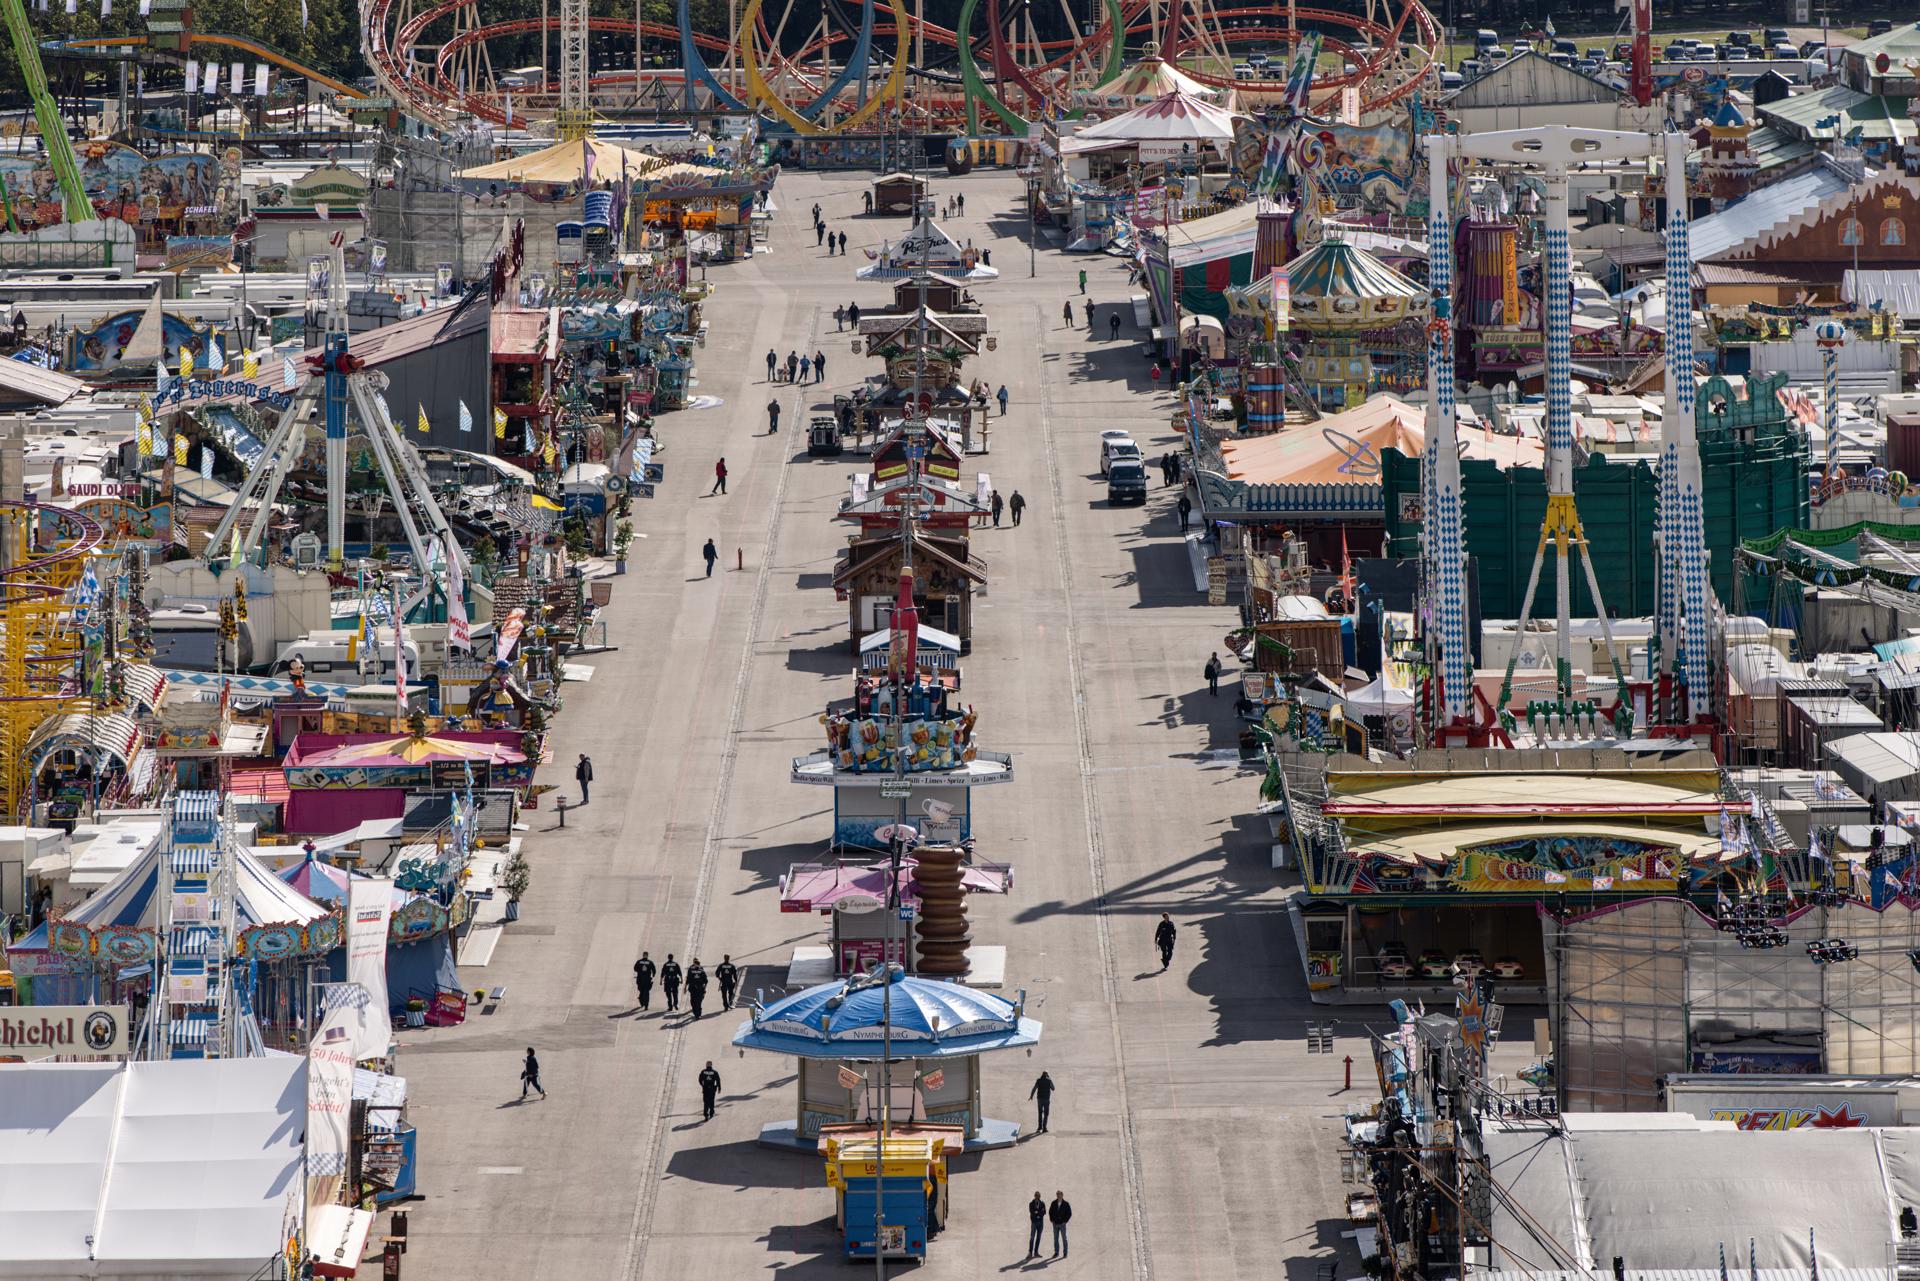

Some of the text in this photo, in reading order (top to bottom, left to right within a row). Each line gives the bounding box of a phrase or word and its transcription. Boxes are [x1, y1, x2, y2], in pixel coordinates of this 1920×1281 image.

[902, 237, 949, 256] Peahes
[188, 379, 292, 412] Tegernsee
[68, 484, 102, 497] GAUDI
[901, 910, 913, 918] WC
[0, 1017, 75, 1049] hichtl
[955, 1022, 997, 1036] NYMPHENBURG
